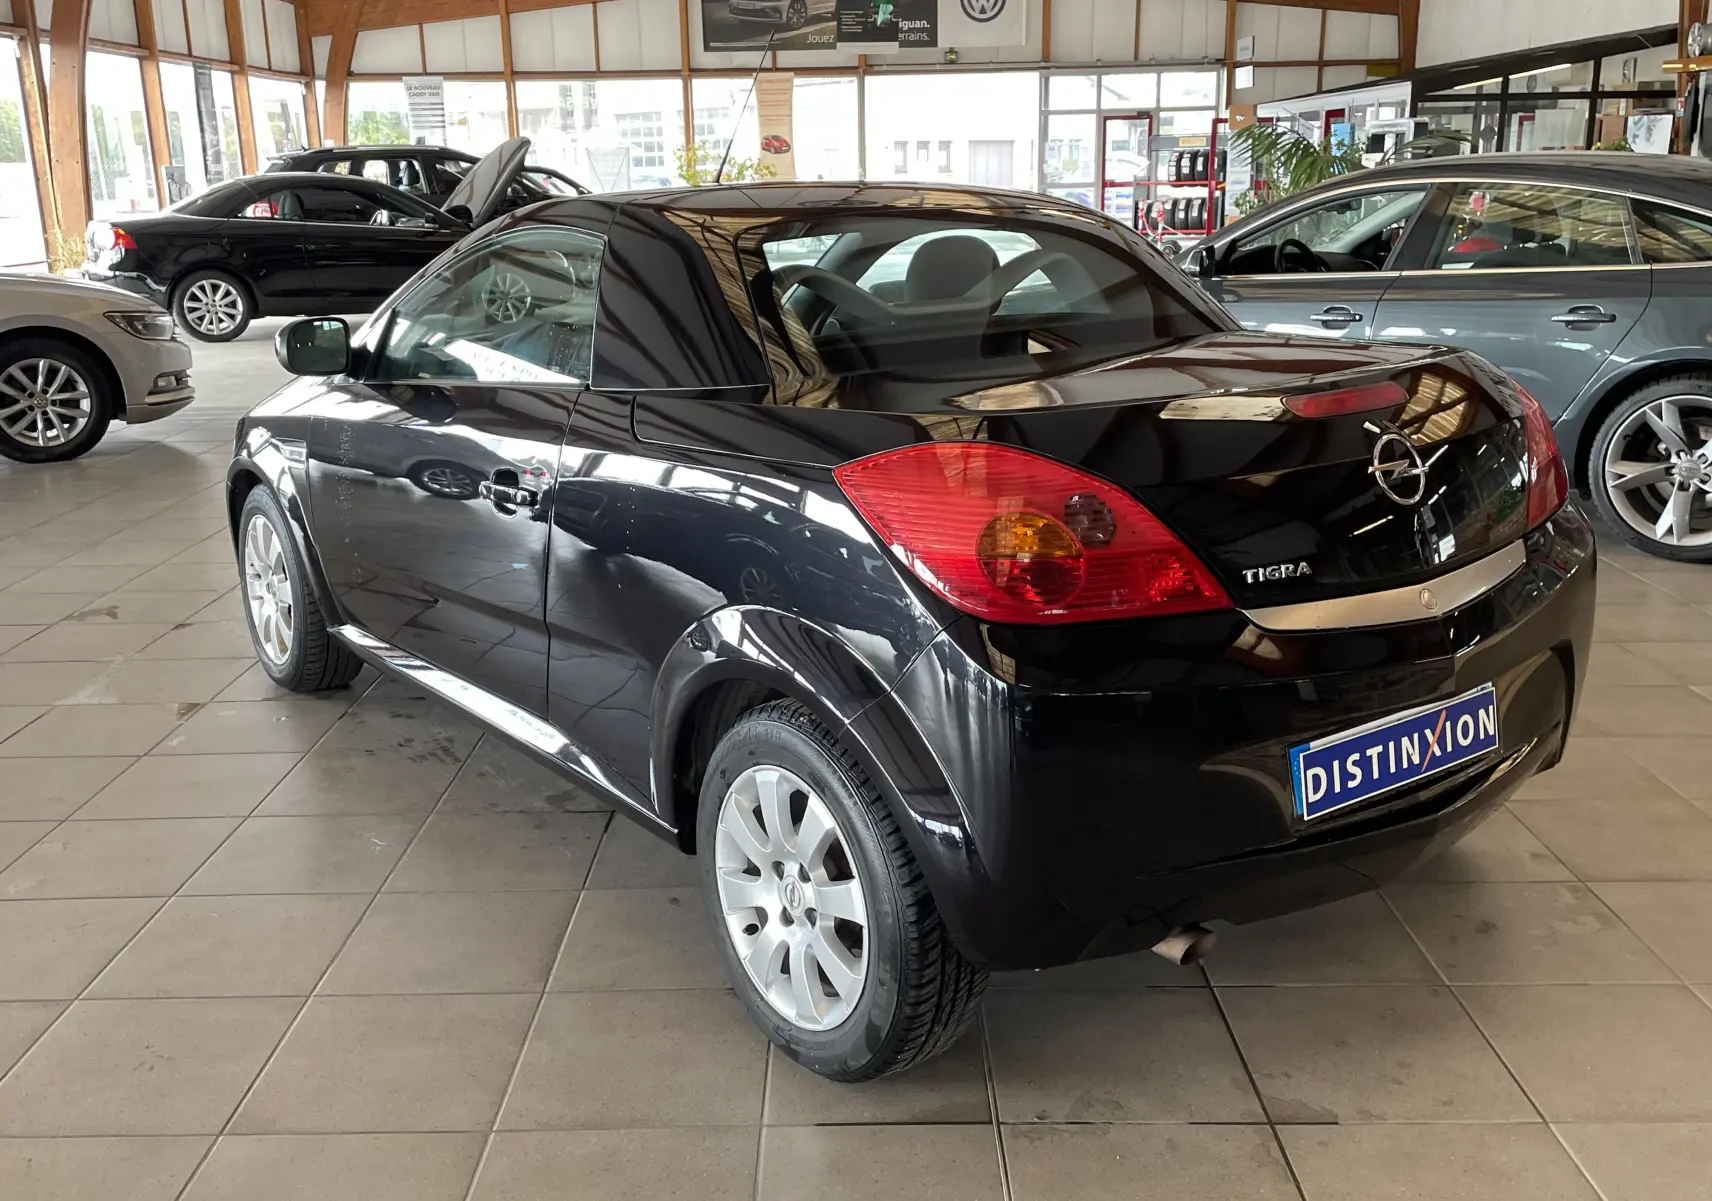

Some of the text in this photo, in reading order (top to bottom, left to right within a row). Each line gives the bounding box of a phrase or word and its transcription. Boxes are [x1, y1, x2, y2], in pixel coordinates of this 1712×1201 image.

[898, 19, 931, 31] iguan.
[806, 33, 834, 44] Jouez
[897, 31, 931, 41] errains.
[1242, 561, 1313, 584] TIGRA
[1306, 704, 1496, 804] DISTINXION
